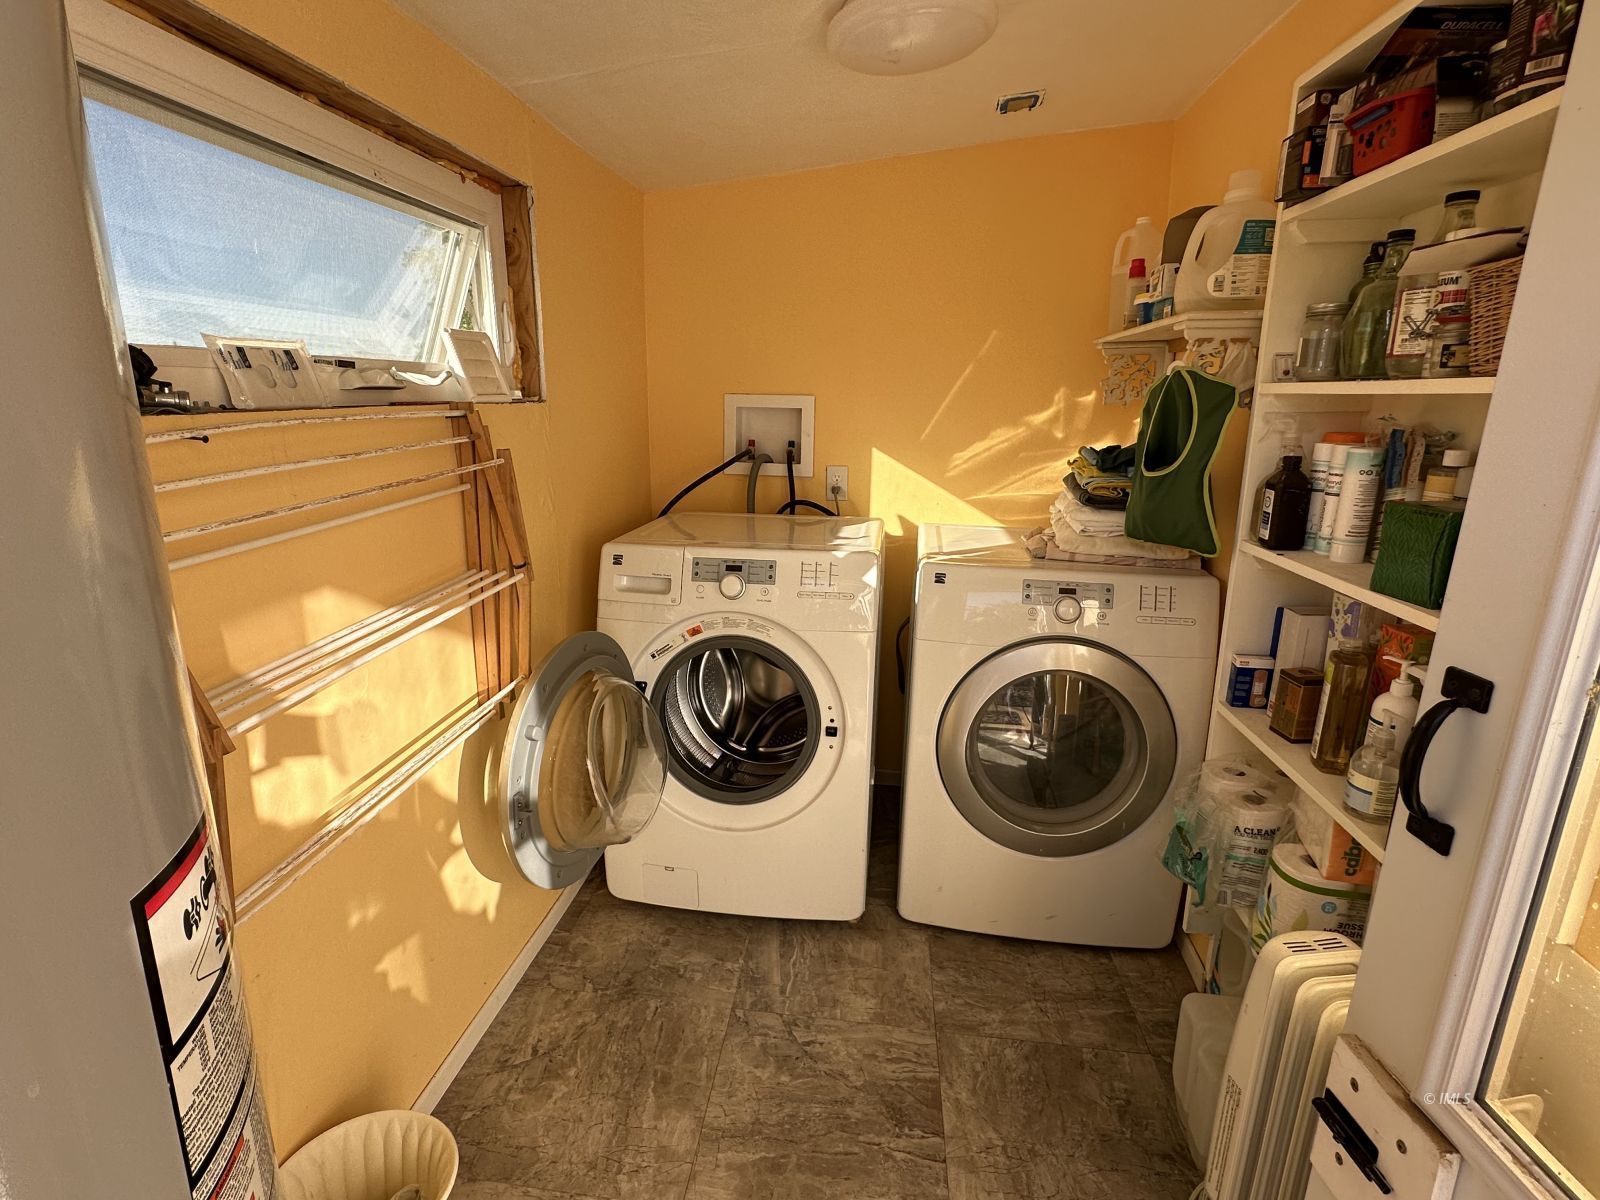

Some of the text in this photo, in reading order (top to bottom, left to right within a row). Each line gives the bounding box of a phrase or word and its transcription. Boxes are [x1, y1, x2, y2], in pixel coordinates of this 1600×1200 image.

[1440, 21, 1504, 30] DURACELL
[1437, 276, 1459, 286] EUM
[1234, 825, 1242, 833] A
